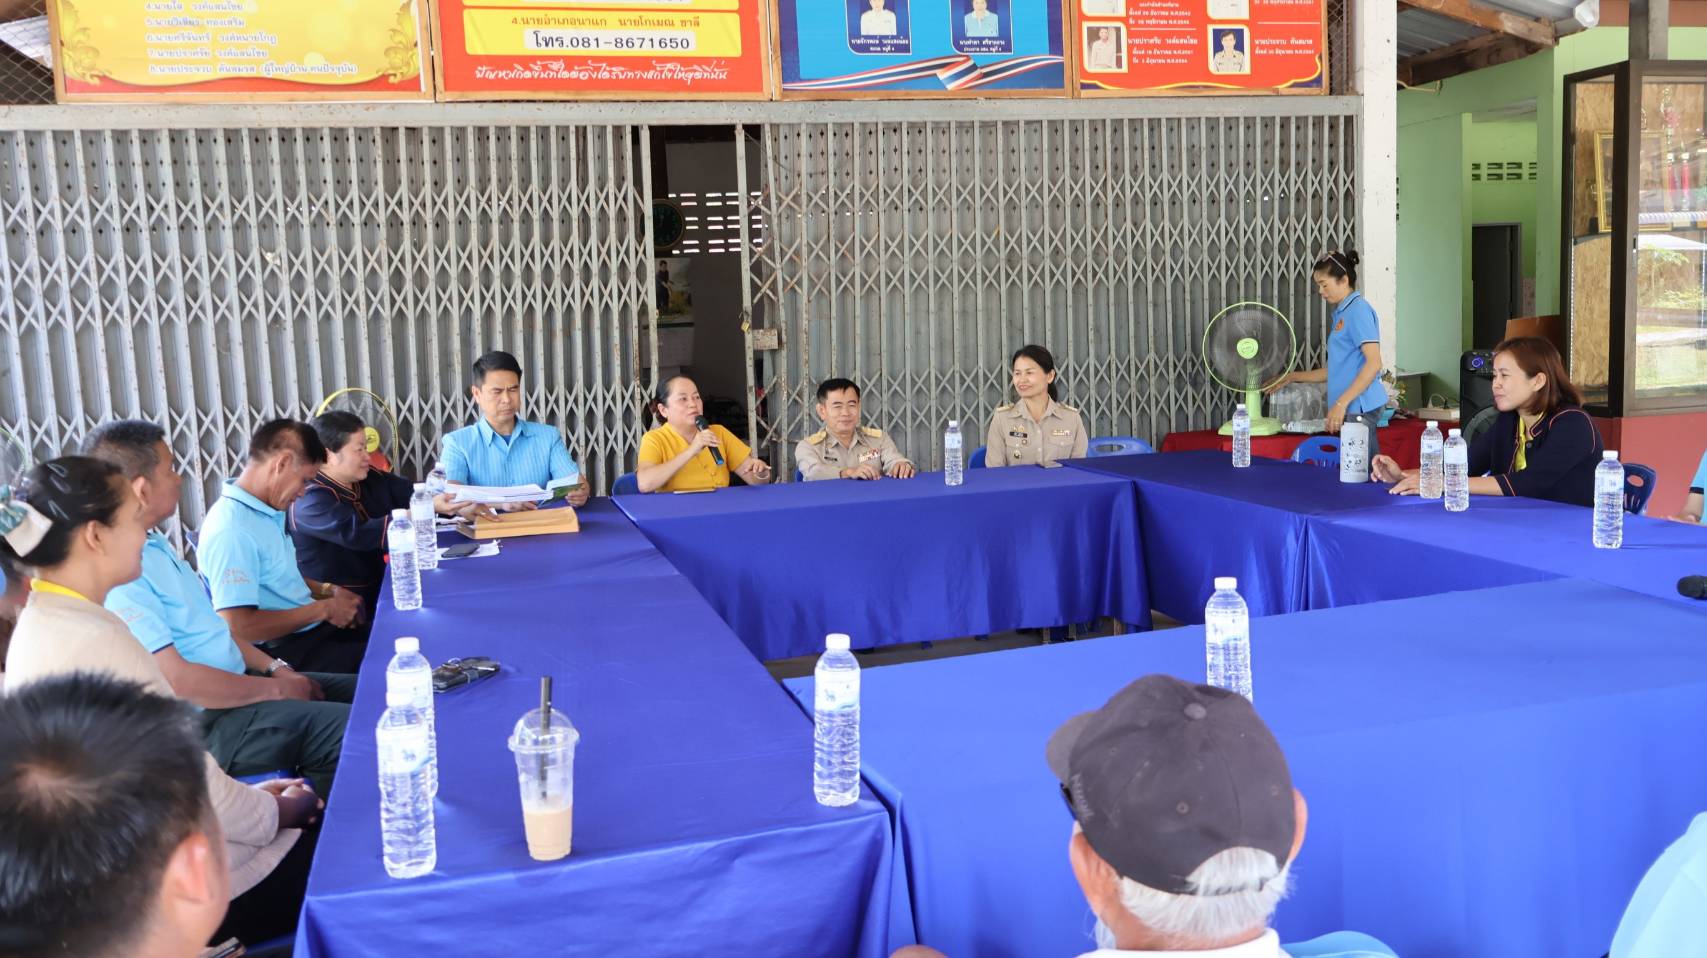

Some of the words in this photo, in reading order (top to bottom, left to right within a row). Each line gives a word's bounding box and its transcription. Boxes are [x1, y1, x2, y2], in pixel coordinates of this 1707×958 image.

[511, 14, 607, 27] 4.นายอำเภอนาแก
[533, 31, 690, 49] โทร.081-8671650
